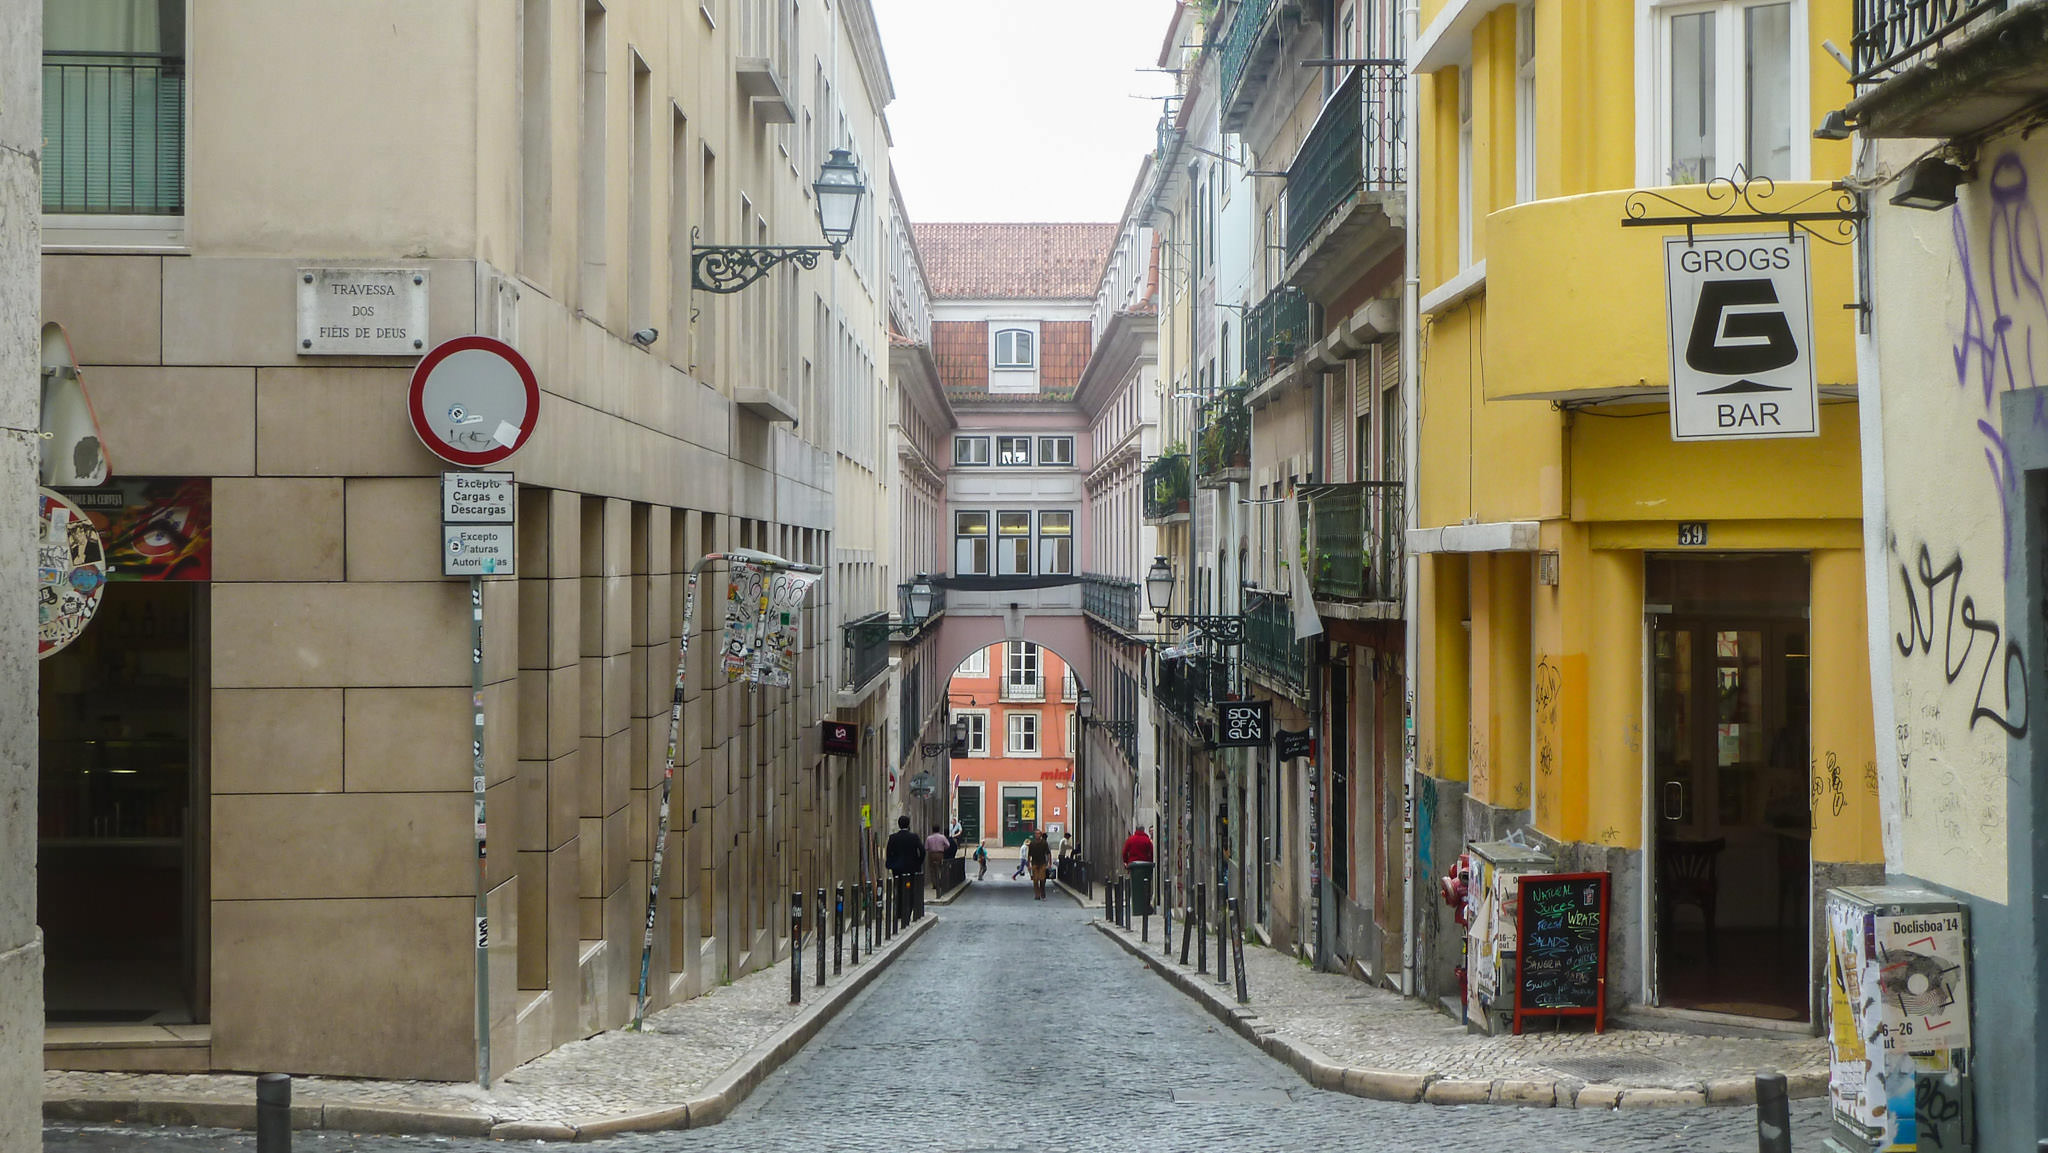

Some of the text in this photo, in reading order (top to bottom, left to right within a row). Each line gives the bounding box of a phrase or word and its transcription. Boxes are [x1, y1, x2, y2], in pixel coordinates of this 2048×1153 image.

[1681, 247, 1790, 272] GROGS
[331, 284, 395, 296] TRAVESSA
[352, 306, 375, 317] DOS
[355, 327, 371, 338] DE
[376, 328, 407, 339] DEUS
[1717, 402, 1781, 428] BAR
[457, 479, 500, 490] Excepto
[453, 491, 491, 502] Cargas
[451, 505, 507, 516] Descargas
[460, 532, 498, 543] Excepto
[1681, 523, 1703, 545] 39
[452, 558, 507, 567] Autorias
[1228, 708, 1261, 720] SON
[1231, 719, 1258, 728] OF A
[1228, 728, 1261, 739] GUN
[1533, 884, 1575, 902] NATURAL
[1567, 909, 1600, 926] WRAPS
[1528, 932, 1570, 948] SALADS
